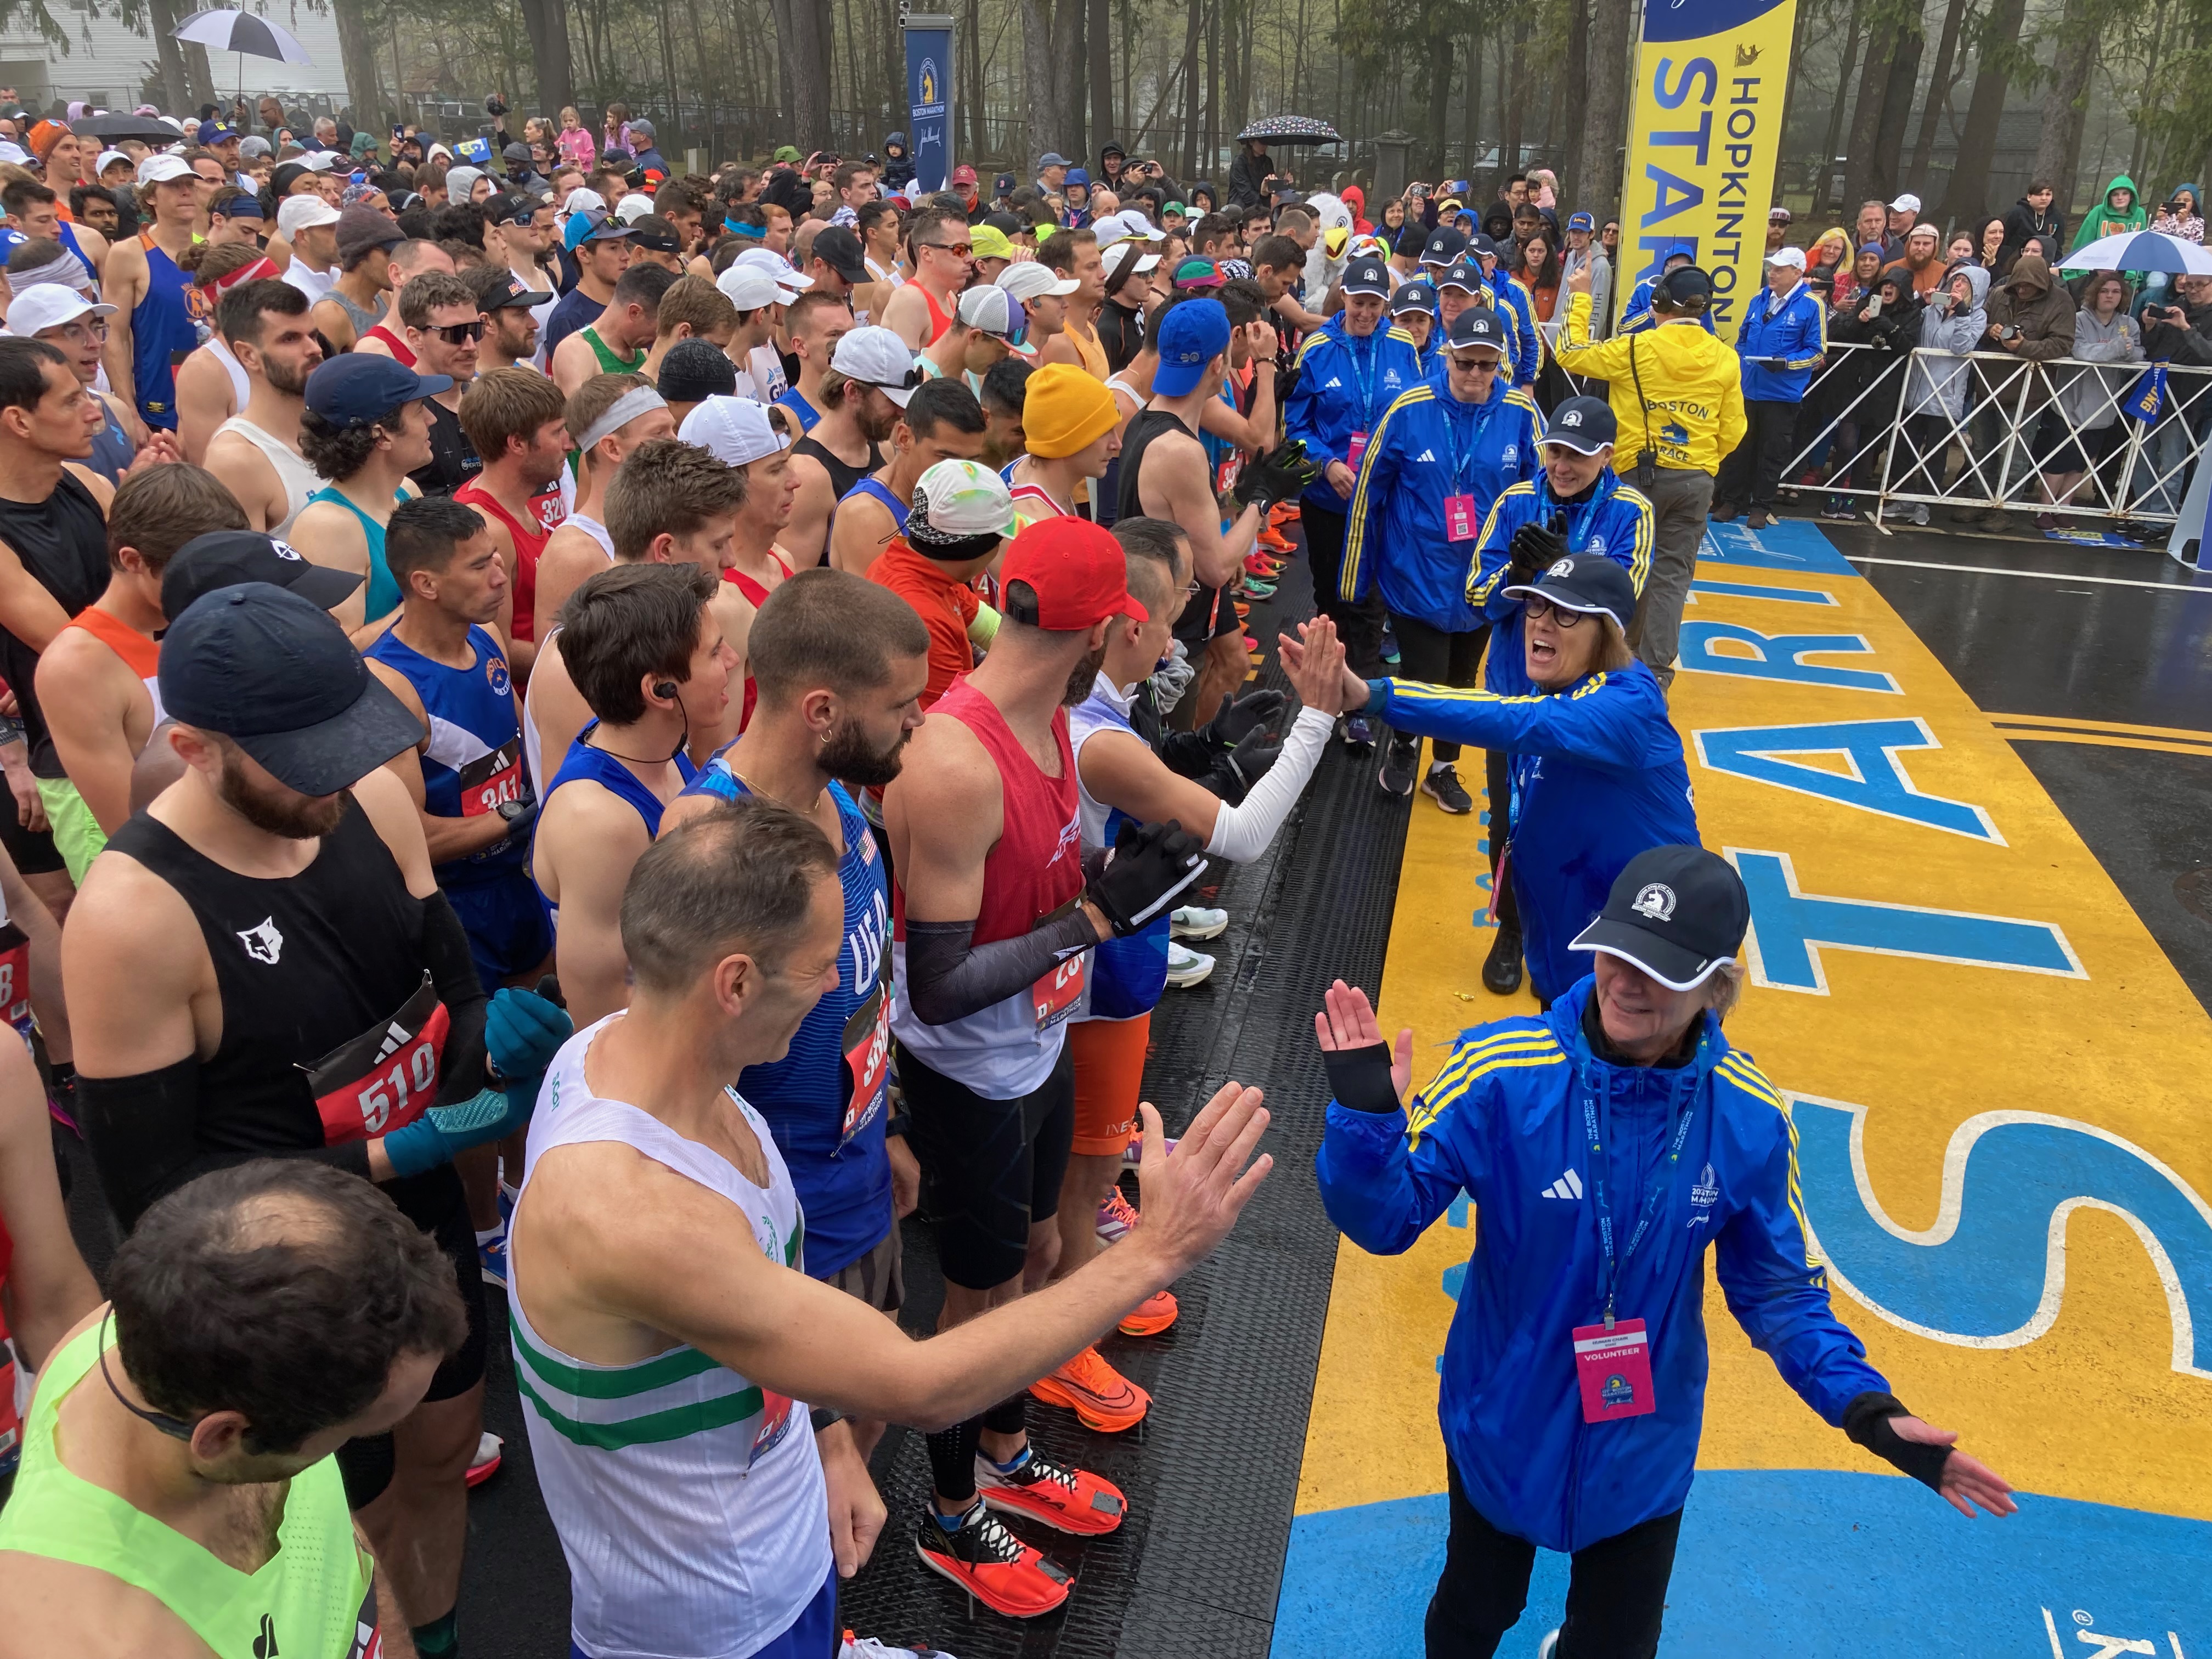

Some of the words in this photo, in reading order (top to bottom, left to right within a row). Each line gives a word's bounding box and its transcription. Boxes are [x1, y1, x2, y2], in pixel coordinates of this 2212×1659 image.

[912, 108, 927, 117] BOSTON
[927, 105, 945, 115] MARATHON
[1712, 77, 1761, 323] HOPKINTON
[1647, 400, 1709, 420] BOSTON
[1659, 445, 1689, 461] RACE
[1638, 888, 1648, 903] BOSTON
[1665, 889, 1675, 913] ASSOCIATION
[849, 888, 887, 996] USA
[358, 1042, 435, 1133] 510
[867, 1088, 883, 1113] BOSTON
[857, 1097, 883, 1132] MARATHON
[1583, 1099, 1592, 1126] BOSTON
[1589, 1099, 1599, 1140] MARATHON
[1678, 1110, 1690, 1137] BOSTON
[1677, 1111, 1693, 1151] MARATHON
[1600, 1217, 1609, 1244] BOSTON
[1606, 1217, 1614, 1256] MARATHON
[1584, 1347, 1640, 1362] VOLUNTEER
